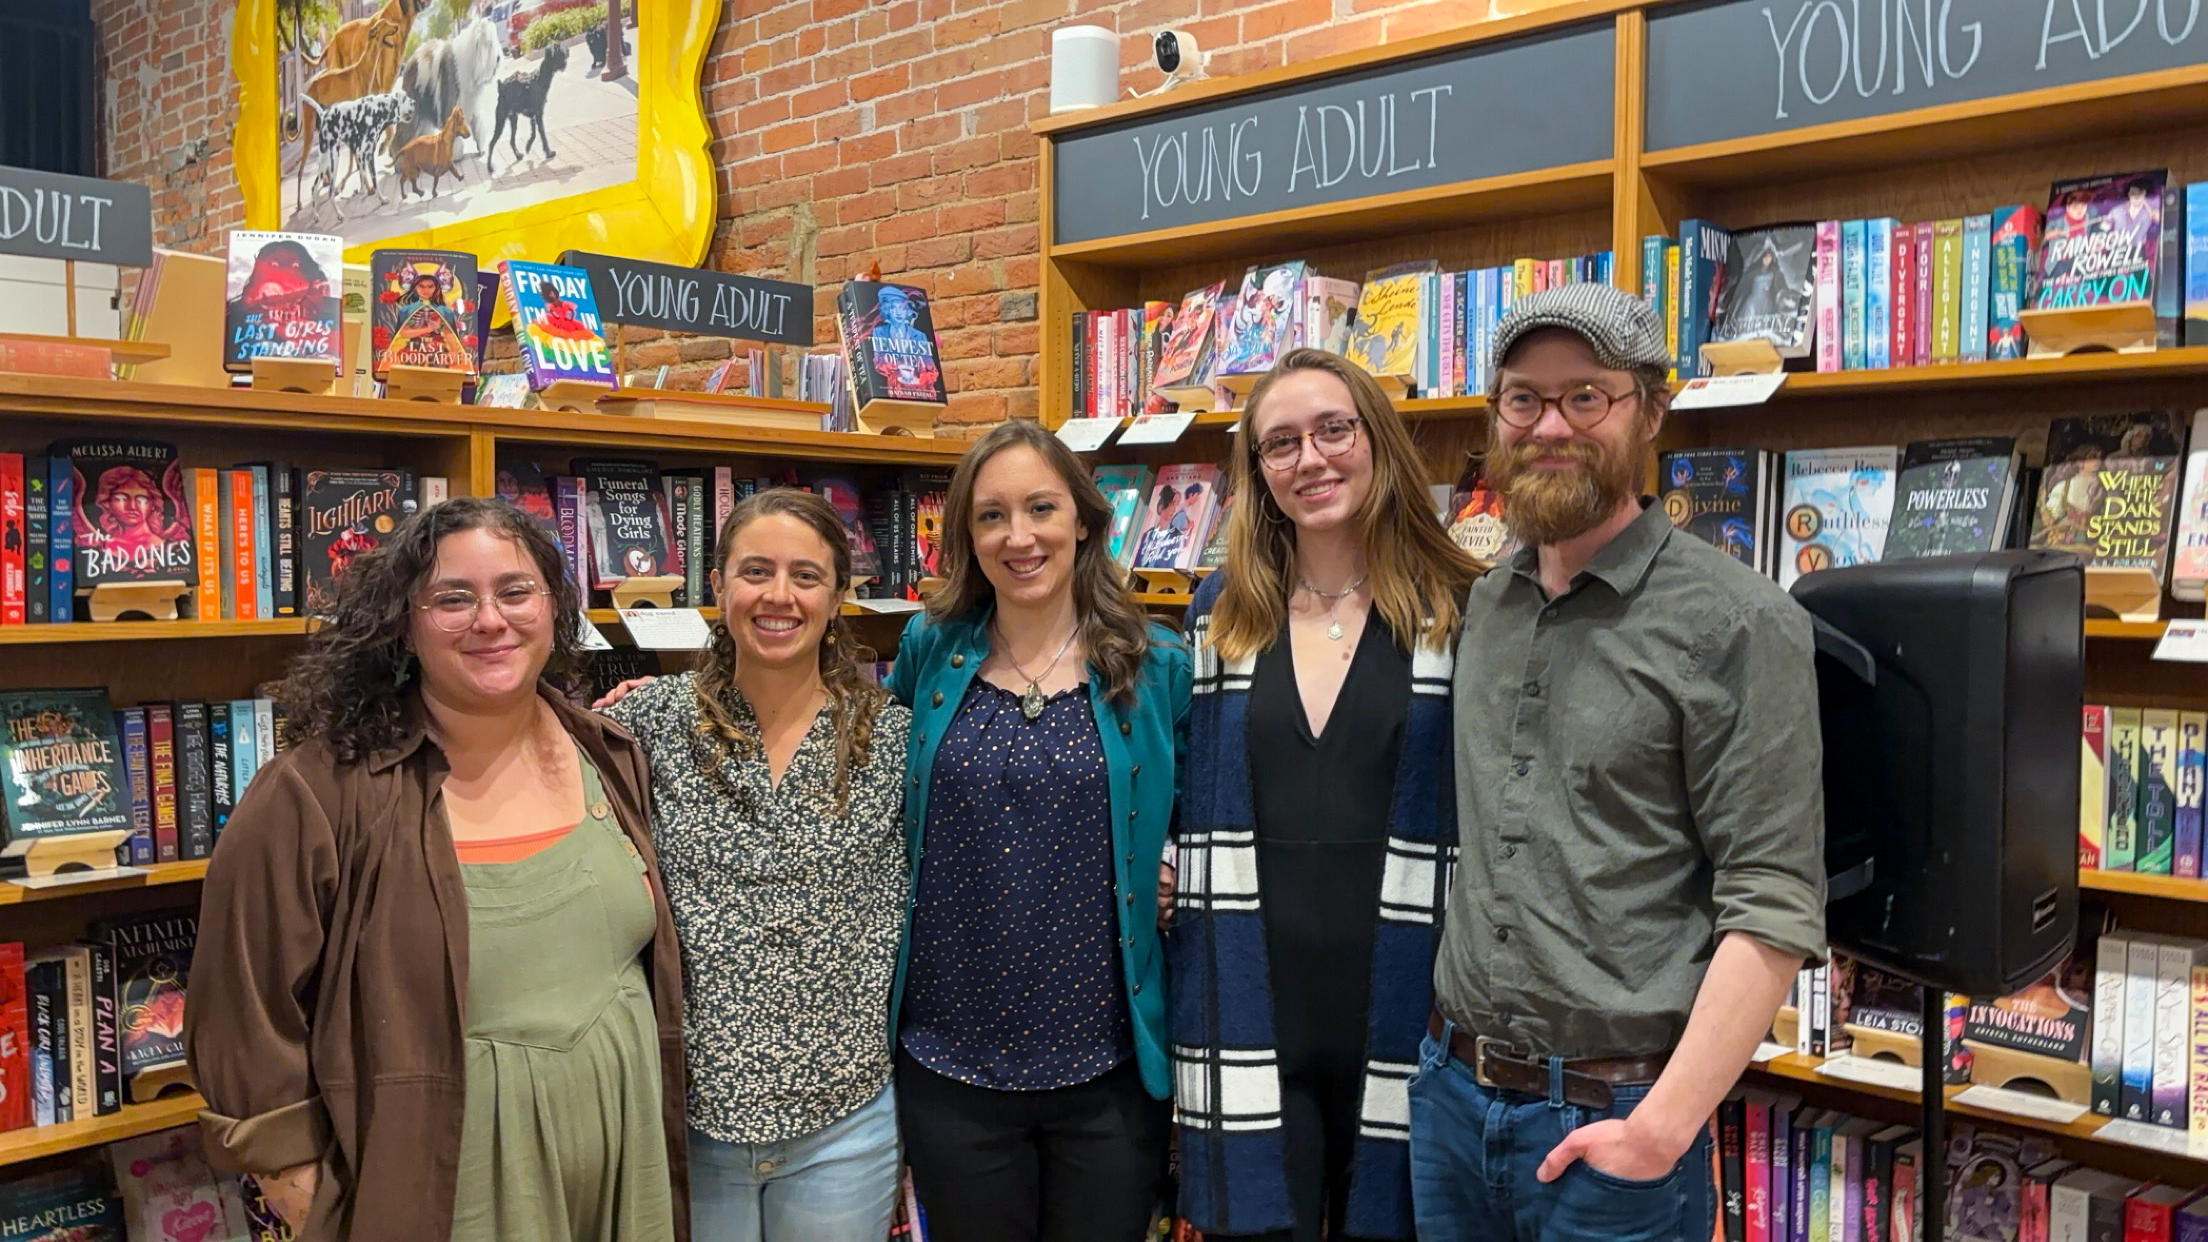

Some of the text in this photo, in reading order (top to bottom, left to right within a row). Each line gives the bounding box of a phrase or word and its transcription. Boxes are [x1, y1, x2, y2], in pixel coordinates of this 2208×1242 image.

[1762, 0, 1982, 119] YOUNG
[1133, 85, 1452, 219] YOUNG ADULT
[236, 232, 338, 243] JENNIFER DUGAN
[2051, 224, 2140, 262] RAINBOW
[1920, 240, 1928, 291] FOUR
[2071, 241, 2143, 276] ROWELL
[1897, 244, 1907, 356] DIVERGENT
[1940, 240, 1951, 354] ALLEGIANT
[1970, 236, 1980, 350] INSURGENT
[2038, 279, 2105, 311] CARRY
[2109, 268, 2149, 303] ON
[609, 268, 792, 336] YOUNG ADULT
[246, 314, 263, 324] THE
[524, 306, 598, 331] I'M IN
[235, 319, 335, 344] LAST GIRLS
[237, 337, 328, 360] STANDING
[380, 350, 472, 365] BLOODCARVER
[409, 341, 444, 352] LAST
[533, 336, 611, 375] LOVE
[868, 336, 933, 357] TEMPEST
[521, 347, 534, 375] LOVE
[884, 353, 926, 372] OF TEA
[72, 445, 168, 459] MELISSA ALBERT
[1792, 460, 1889, 476] Rebecca Ross
[598, 477, 649, 490] Funeral
[2098, 470, 2163, 490] WHERE
[605, 489, 646, 505] Songs
[619, 501, 638, 514] for
[1664, 494, 1741, 518] Divine
[1907, 488, 1989, 511] POWERLESS
[2124, 489, 2157, 503] THE
[307, 488, 399, 538] LIGHTLARK
[677, 503, 686, 537] Made
[894, 513, 899, 523] OF
[911, 512, 915, 522] OF
[2103, 497, 2162, 520] DARK
[610, 513, 652, 530] Dying
[617, 526, 651, 539] Girls
[693, 486, 702, 558] GODLY HEATHENS
[894, 525, 899, 533] US
[1797, 511, 1890, 533] Ruthless
[2087, 515, 2160, 538] STANDS
[80, 529, 114, 544] The
[238, 508, 250, 585] HERE'S TO US
[278, 498, 293, 592] HEARTS STILL BEATING
[2096, 534, 2156, 557] STILL
[81, 540, 191, 578] BAD ONES
[203, 503, 215, 595] WHAT IF IT'S US
[599, 662, 640, 675] TRUE
[8, 718, 38, 741] THE
[129, 732, 144, 751] THE
[15, 741, 113, 774] INHERITANCE
[61, 771, 111, 796] GAMES
[154, 741, 176, 830] THE FINAL GAMBIT
[215, 742, 230, 806] THE NATURALS
[21, 815, 126, 831] JENNIFER LYNN BARNES
[104, 918, 197, 947] INFINITY
[2012, 999, 2038, 1012] THE
[1856, 1012, 1886, 1028] LEIA
[1969, 1005, 2076, 1042] INVOCATIONS
[96, 995, 116, 1074] PLAN A
[1975, 1027, 2066, 1051] CRYSTAL SUTHERLAND
[2, 1198, 106, 1237] HEARTLESS
